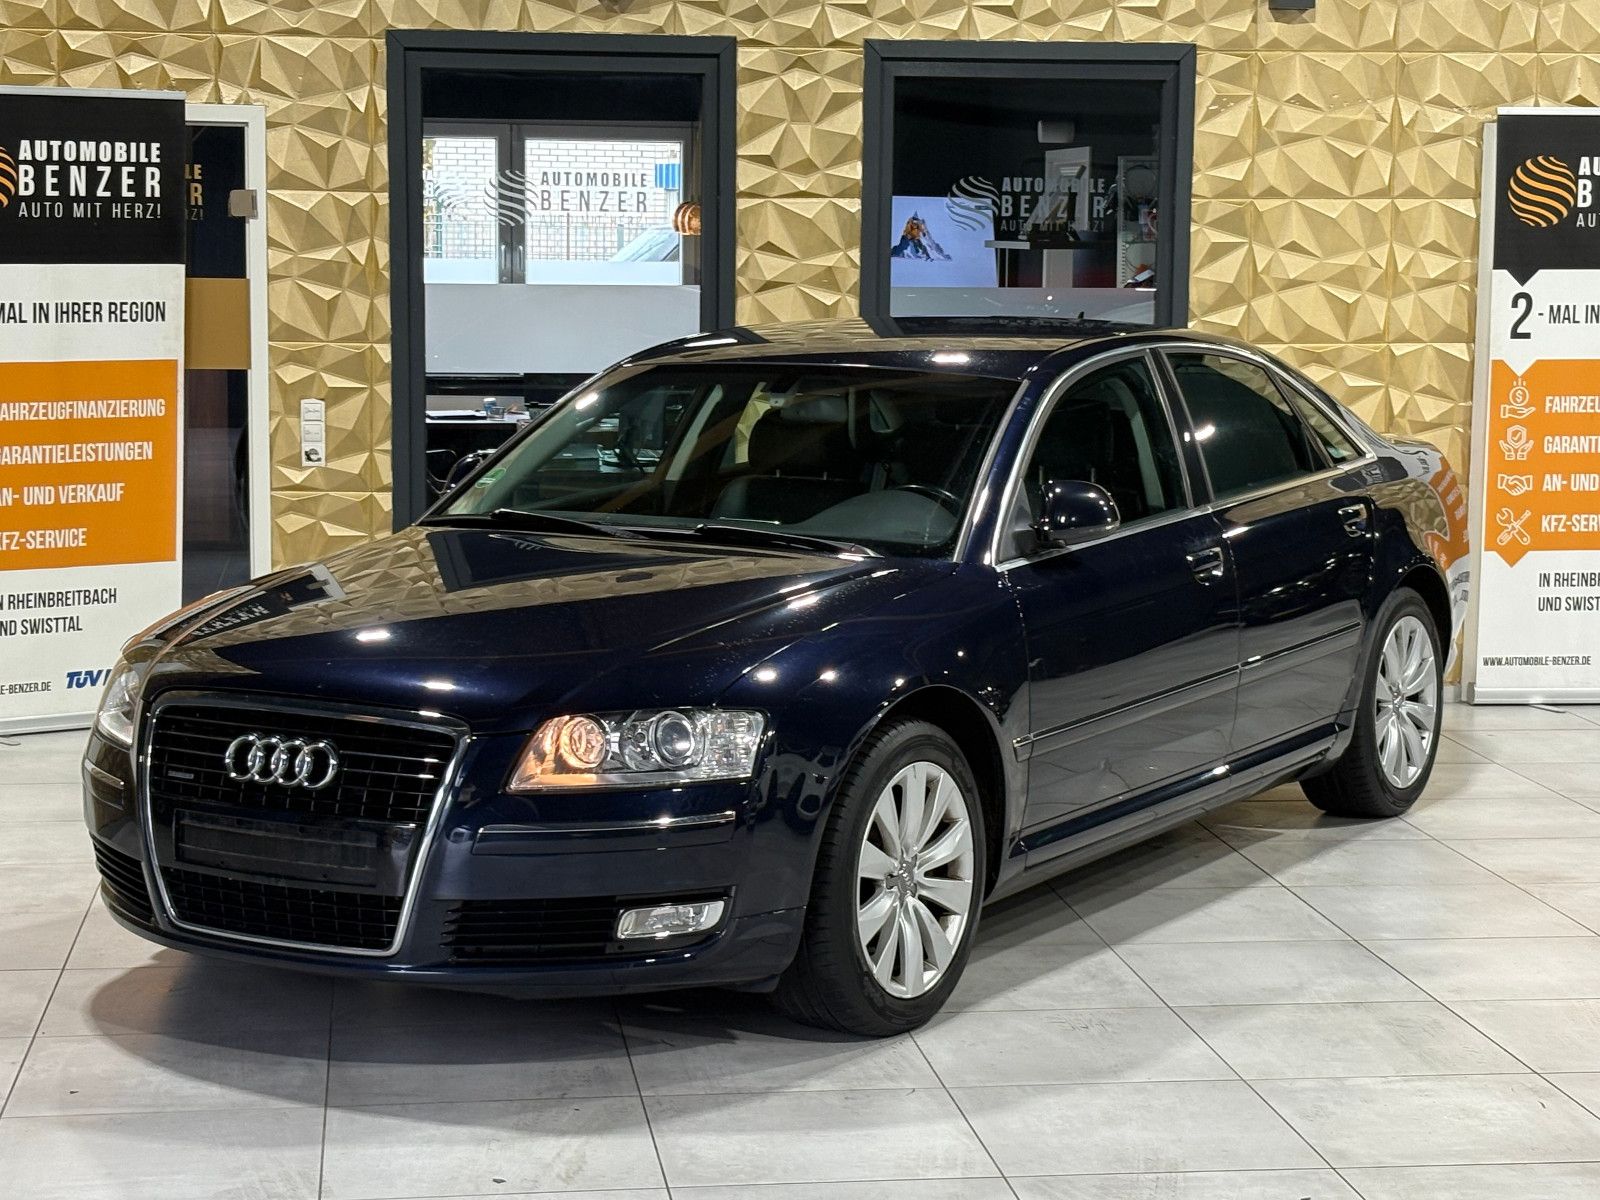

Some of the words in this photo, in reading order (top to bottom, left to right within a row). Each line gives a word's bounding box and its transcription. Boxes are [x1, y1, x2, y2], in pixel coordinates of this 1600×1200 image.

[18, 140, 161, 163] AUTOMOBILE
[18, 164, 161, 197] BENZER
[541, 171, 648, 187] AUTOMOBILE
[1001, 176, 1105, 193] AUTOMOBLE
[18, 202, 63, 218] AUTO
[73, 202, 102, 218] MIT
[112, 203, 161, 219] HERZ!
[540, 190, 647, 212] BENZER
[1001, 195, 1105, 218] BENZR
[1576, 212, 1600, 228] AU
[33, 302, 50, 323] IN
[55, 302, 103, 323] IHRER
[108, 301, 166, 322] REGION
[1510, 291, 1533, 339] 2
[1548, 304, 1580, 324] MAL
[1585, 304, 1600, 324] IN
[0, 399, 166, 421] AHRZEUGFINANZIERUNG
[0, 441, 153, 465] ARANTIELEISTUNGEN
[1542, 473, 1568, 492] AN-
[1570, 473, 1599, 492] UND
[23, 486, 55, 506] UND
[58, 483, 125, 504] VERKAUF
[1541, 513, 1600, 533] KFZ-SER
[0, 528, 88, 551] FZ-SERVICE
[1538, 572, 1551, 587] IN
[8, 588, 117, 610] RHEINBREITBACH
[1538, 596, 1562, 611] UND
[21, 615, 83, 635] SWISTTAL
[1482, 655, 1592, 666] WWW.AUTOMOBILE-BENZER.DE
[0, 681, 52, 695] E-BENZER.DE
